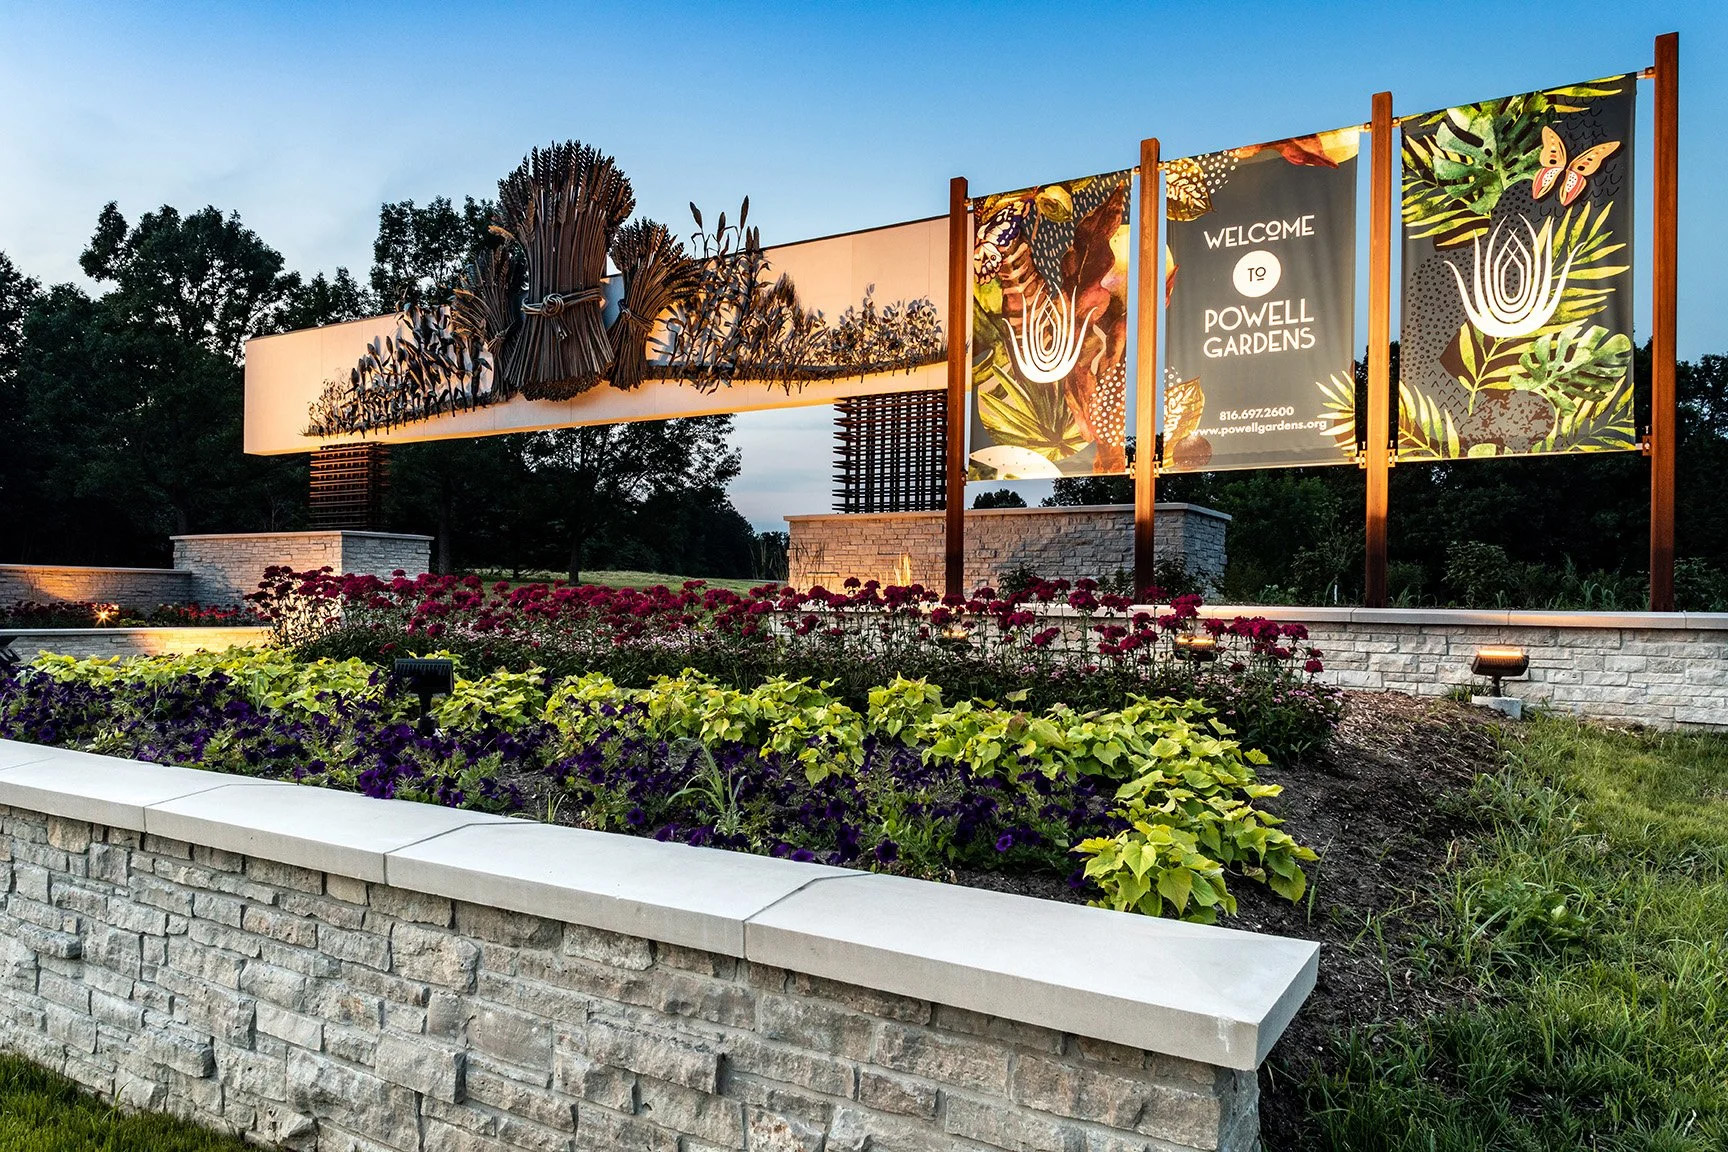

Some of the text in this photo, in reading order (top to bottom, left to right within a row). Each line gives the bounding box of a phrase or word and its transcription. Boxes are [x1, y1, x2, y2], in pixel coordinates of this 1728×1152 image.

[1203, 214, 1315, 250] WELCOME
[1247, 266, 1267, 282] TO
[1204, 298, 1315, 333] POWELL
[1203, 327, 1316, 358] GARDENS
[1219, 406, 1295, 421] 816.697.2600
[1189, 420, 1327, 437] www.powellgardens.org
